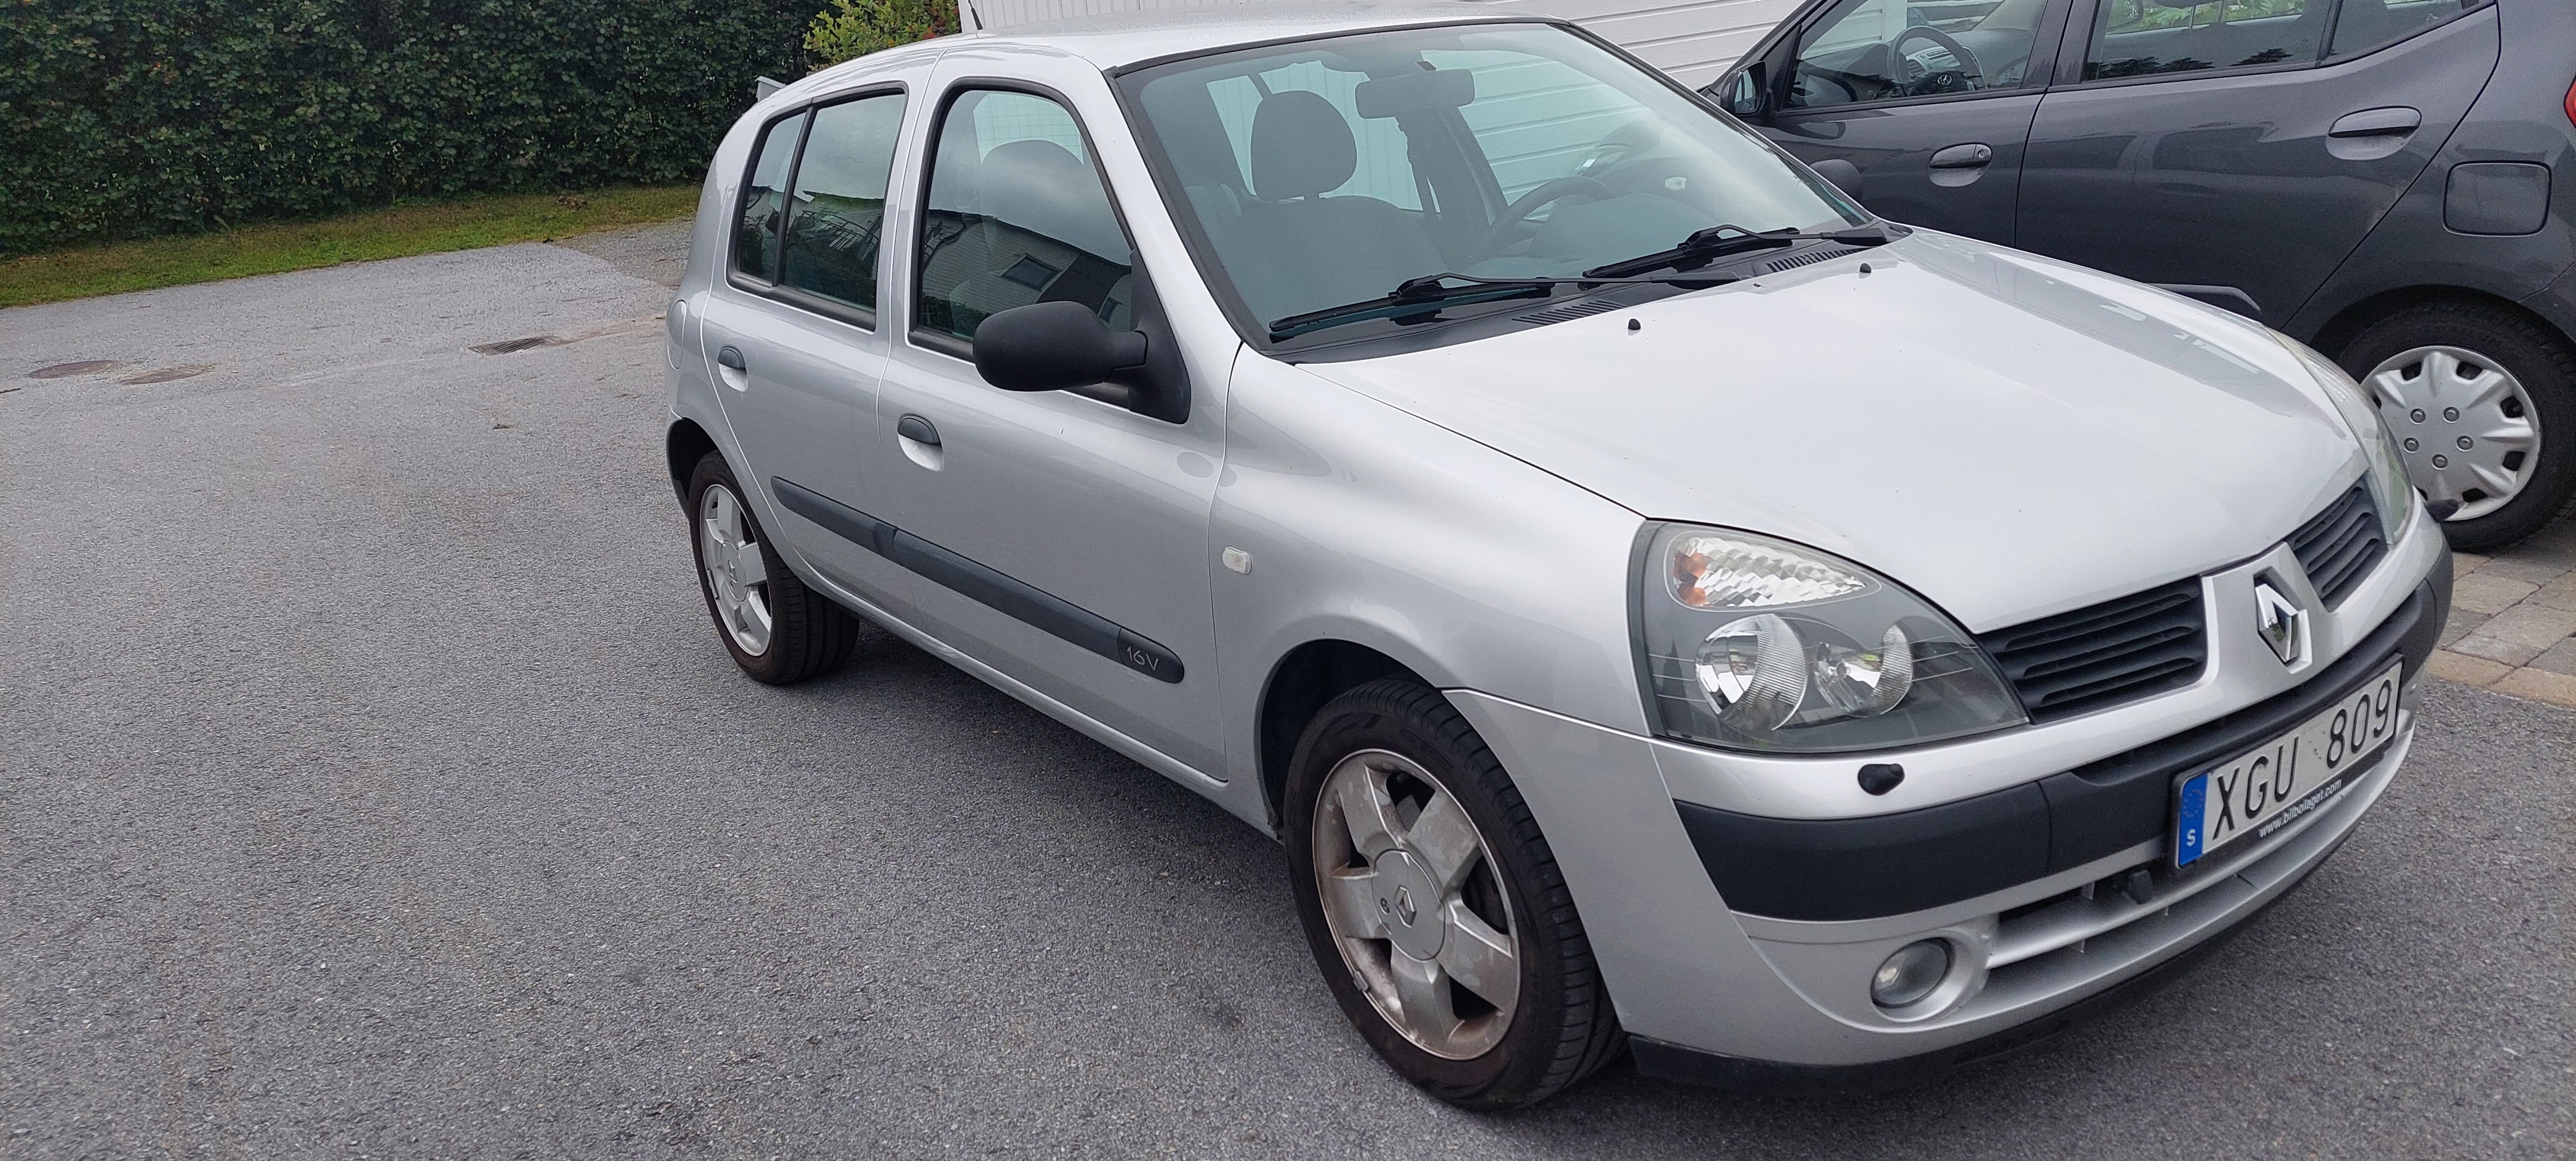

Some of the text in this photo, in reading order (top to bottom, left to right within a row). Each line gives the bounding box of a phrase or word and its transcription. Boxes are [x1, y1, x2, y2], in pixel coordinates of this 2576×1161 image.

[1127, 646, 1159, 671] 16V
[2213, 679, 2392, 840] XGU 809
[2258, 779, 2342, 838] www.bilbolaget.com
[2186, 828, 2196, 847] S
